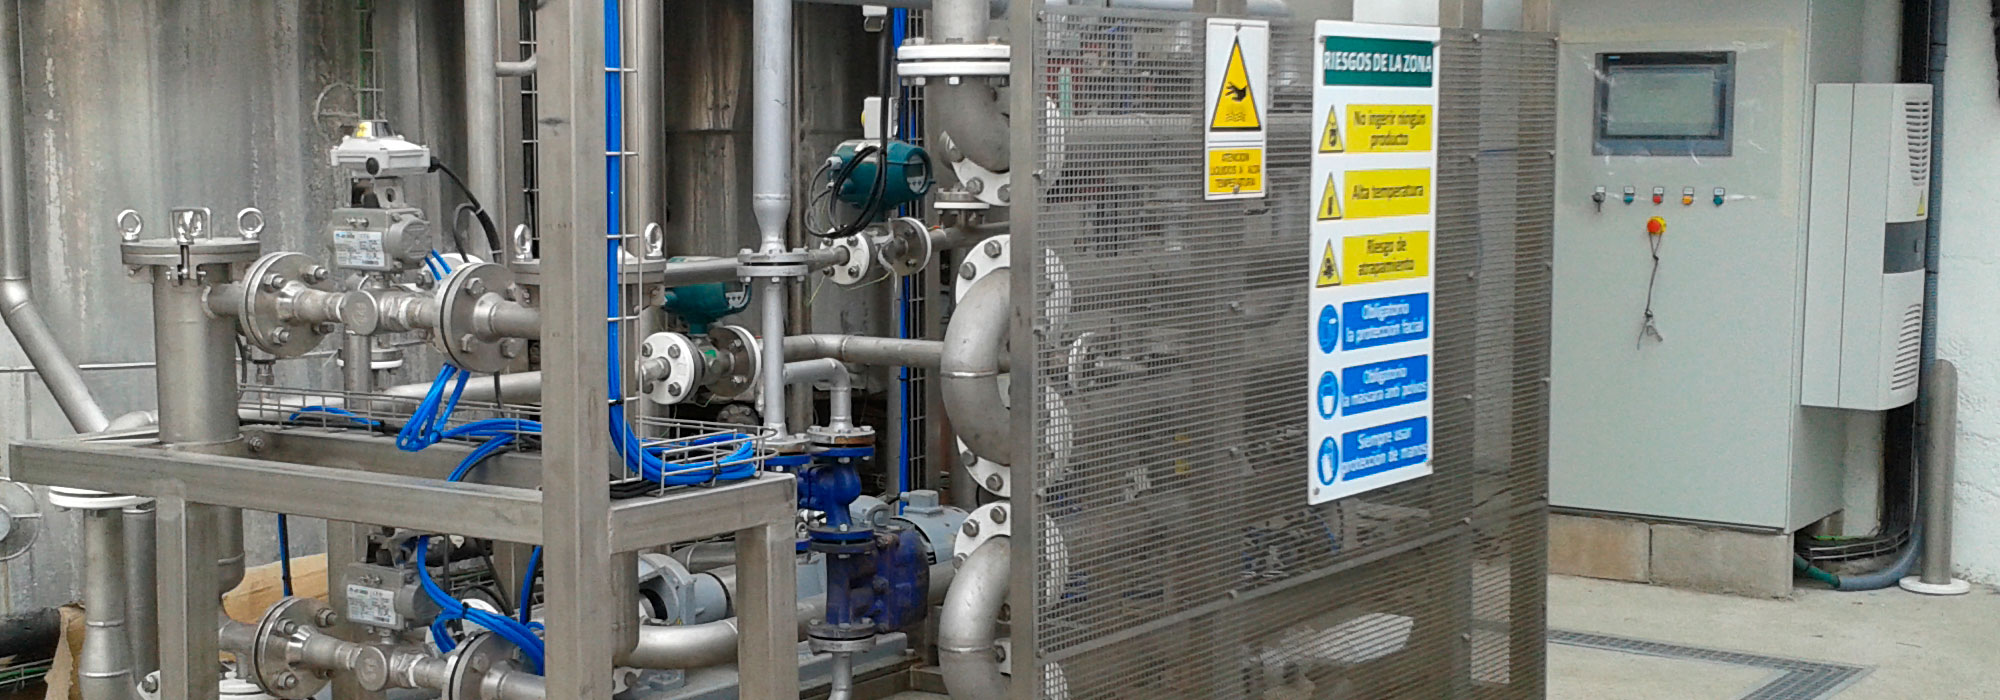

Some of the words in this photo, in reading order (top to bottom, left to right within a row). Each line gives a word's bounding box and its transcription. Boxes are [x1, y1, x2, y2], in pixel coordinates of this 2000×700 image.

[1323, 51, 1371, 71] RIESGOS
[1373, 53, 1388, 72] DE
[1389, 54, 1402, 72] LA
[1403, 55, 1432, 73] ZONA
[1354, 111, 1366, 126] No
[1368, 110, 1395, 129] ingerir
[1370, 131, 1408, 148] producto
[1352, 185, 1369, 200] Alta
[1371, 185, 1423, 201] temperatura
[1367, 240, 1394, 257] Riesgo
[1396, 237, 1407, 252] de
[1358, 258, 1414, 277] atrapamiento
[1362, 300, 1409, 321] Obligatorio
[1345, 327, 1354, 342] la
[1401, 317, 1424, 334] facial
[1362, 364, 1407, 385] Obligatorio
[1341, 394, 1350, 407] la
[1384, 383, 1400, 399] anti
[1357, 432, 1393, 449] Siempre
[1393, 428, 1412, 441] usar
[1388, 447, 1398, 462] de
[1400, 443, 1427, 459] manos
